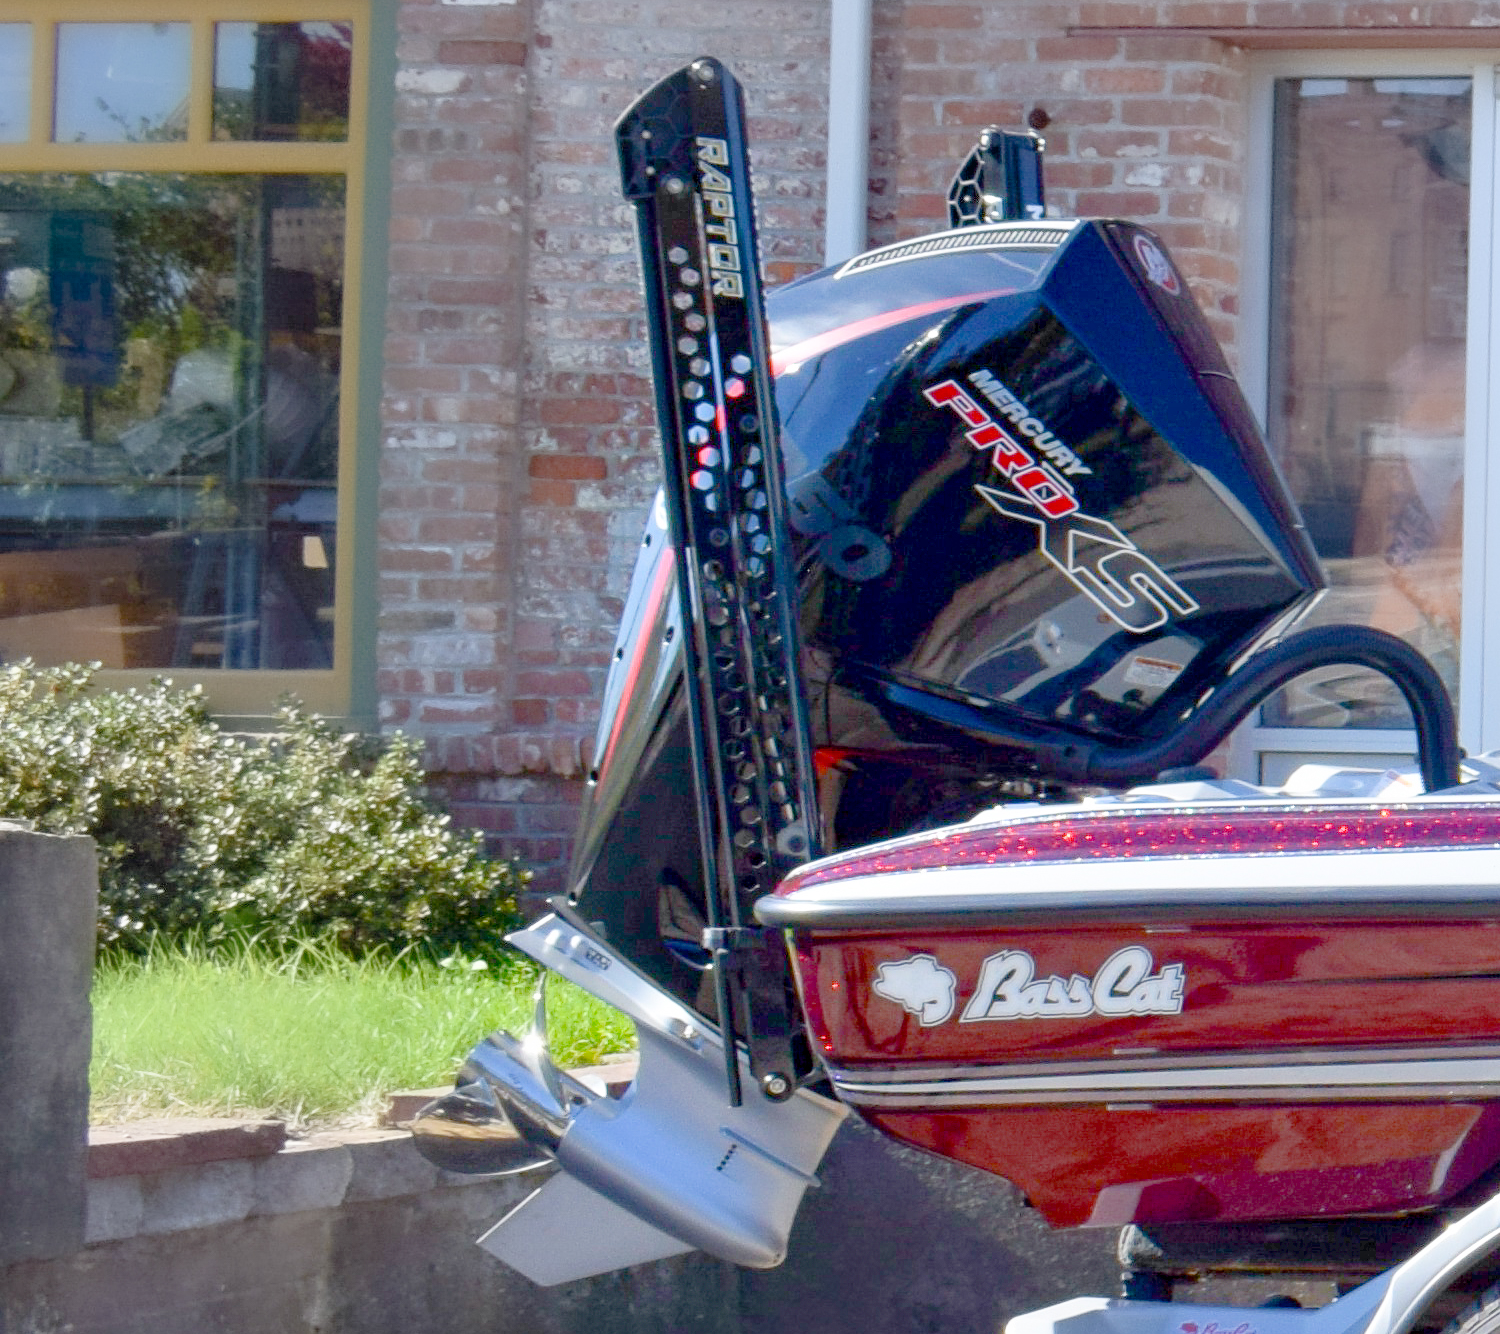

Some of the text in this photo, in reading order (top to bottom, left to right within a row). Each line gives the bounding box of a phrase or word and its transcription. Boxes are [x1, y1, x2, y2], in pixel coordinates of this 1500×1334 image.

[696, 136, 744, 298] RAPTOR
[922, 379, 1080, 519] PRO
[968, 369, 1093, 475] MERCURY
